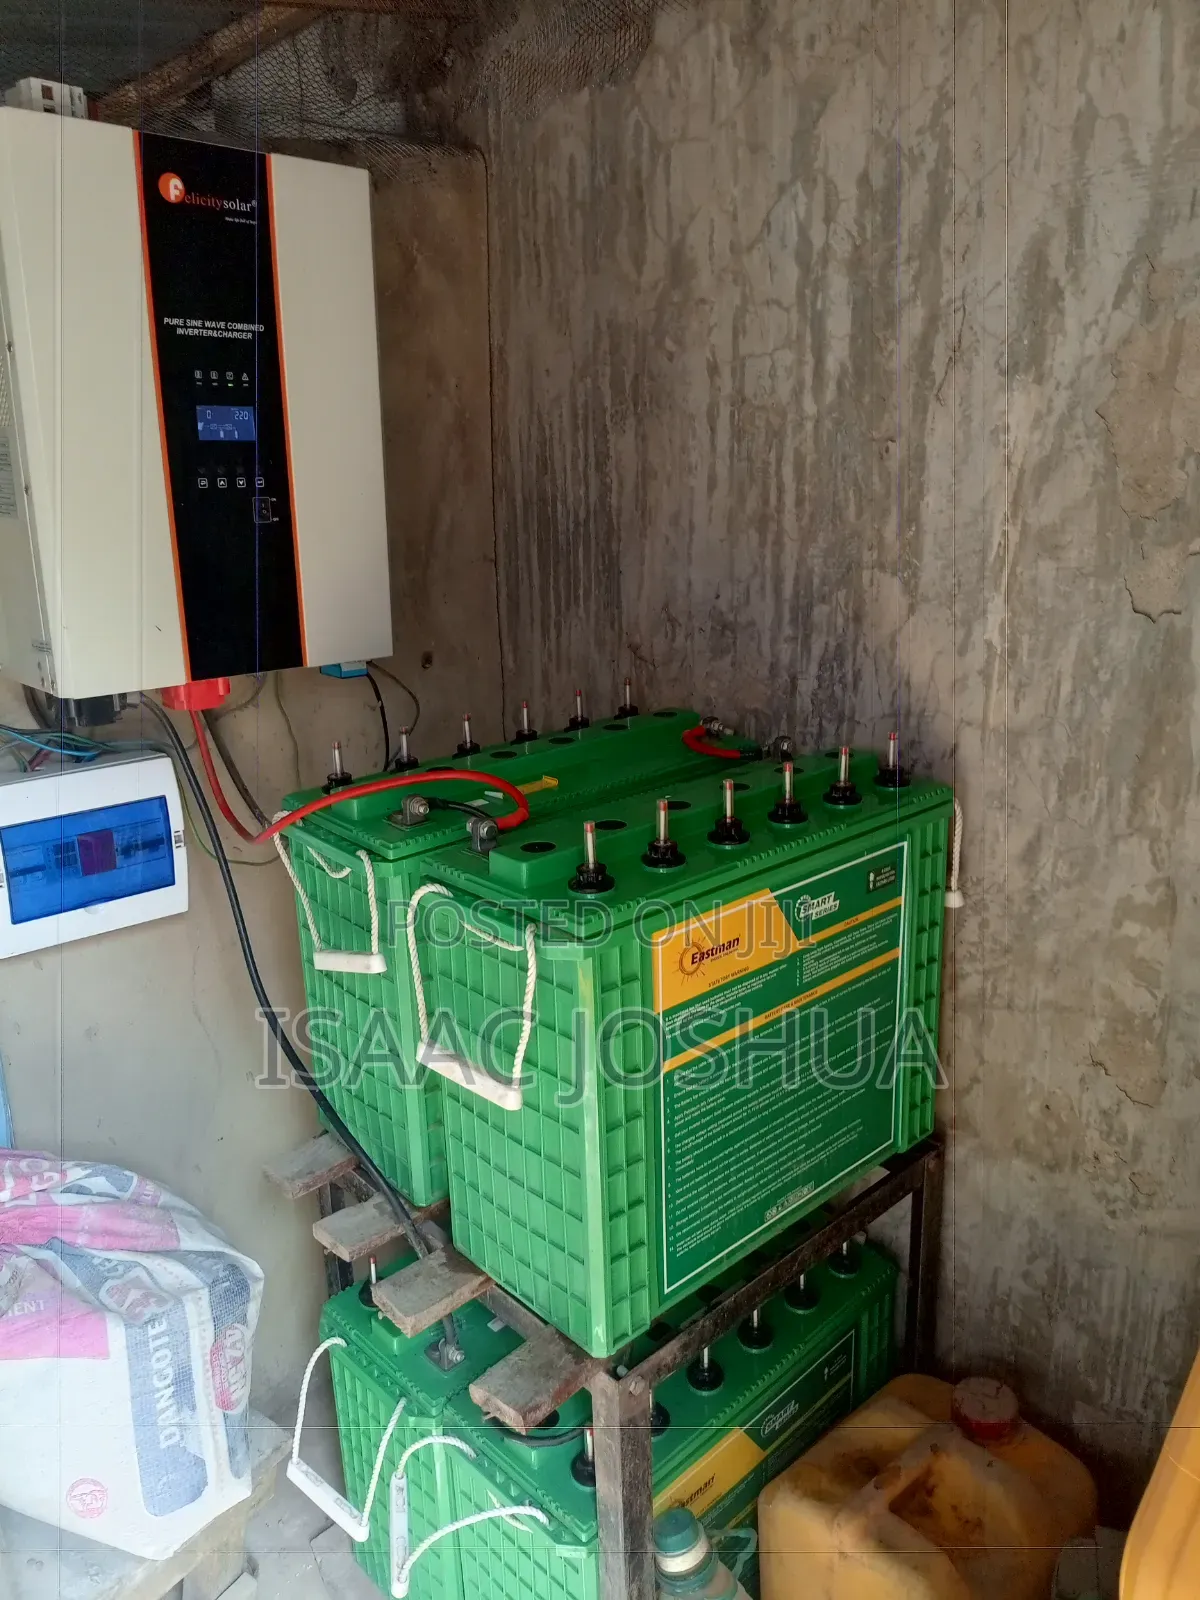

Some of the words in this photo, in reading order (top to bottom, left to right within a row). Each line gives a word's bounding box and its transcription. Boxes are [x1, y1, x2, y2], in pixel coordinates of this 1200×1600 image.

[163, 317, 184, 326] PURE
[185, 318, 204, 328] SINE
[204, 320, 226, 330] WAVE
[227, 321, 265, 332] COMBINED
[176, 327, 253, 340] INVERTER&CHARGER
[234, 410, 249, 420] 220
[802, 894, 833, 915] SMART
[814, 903, 838, 918] SERIES
[691, 936, 740, 966] Eastman
[147, 1318, 182, 1450] DANGOTE
